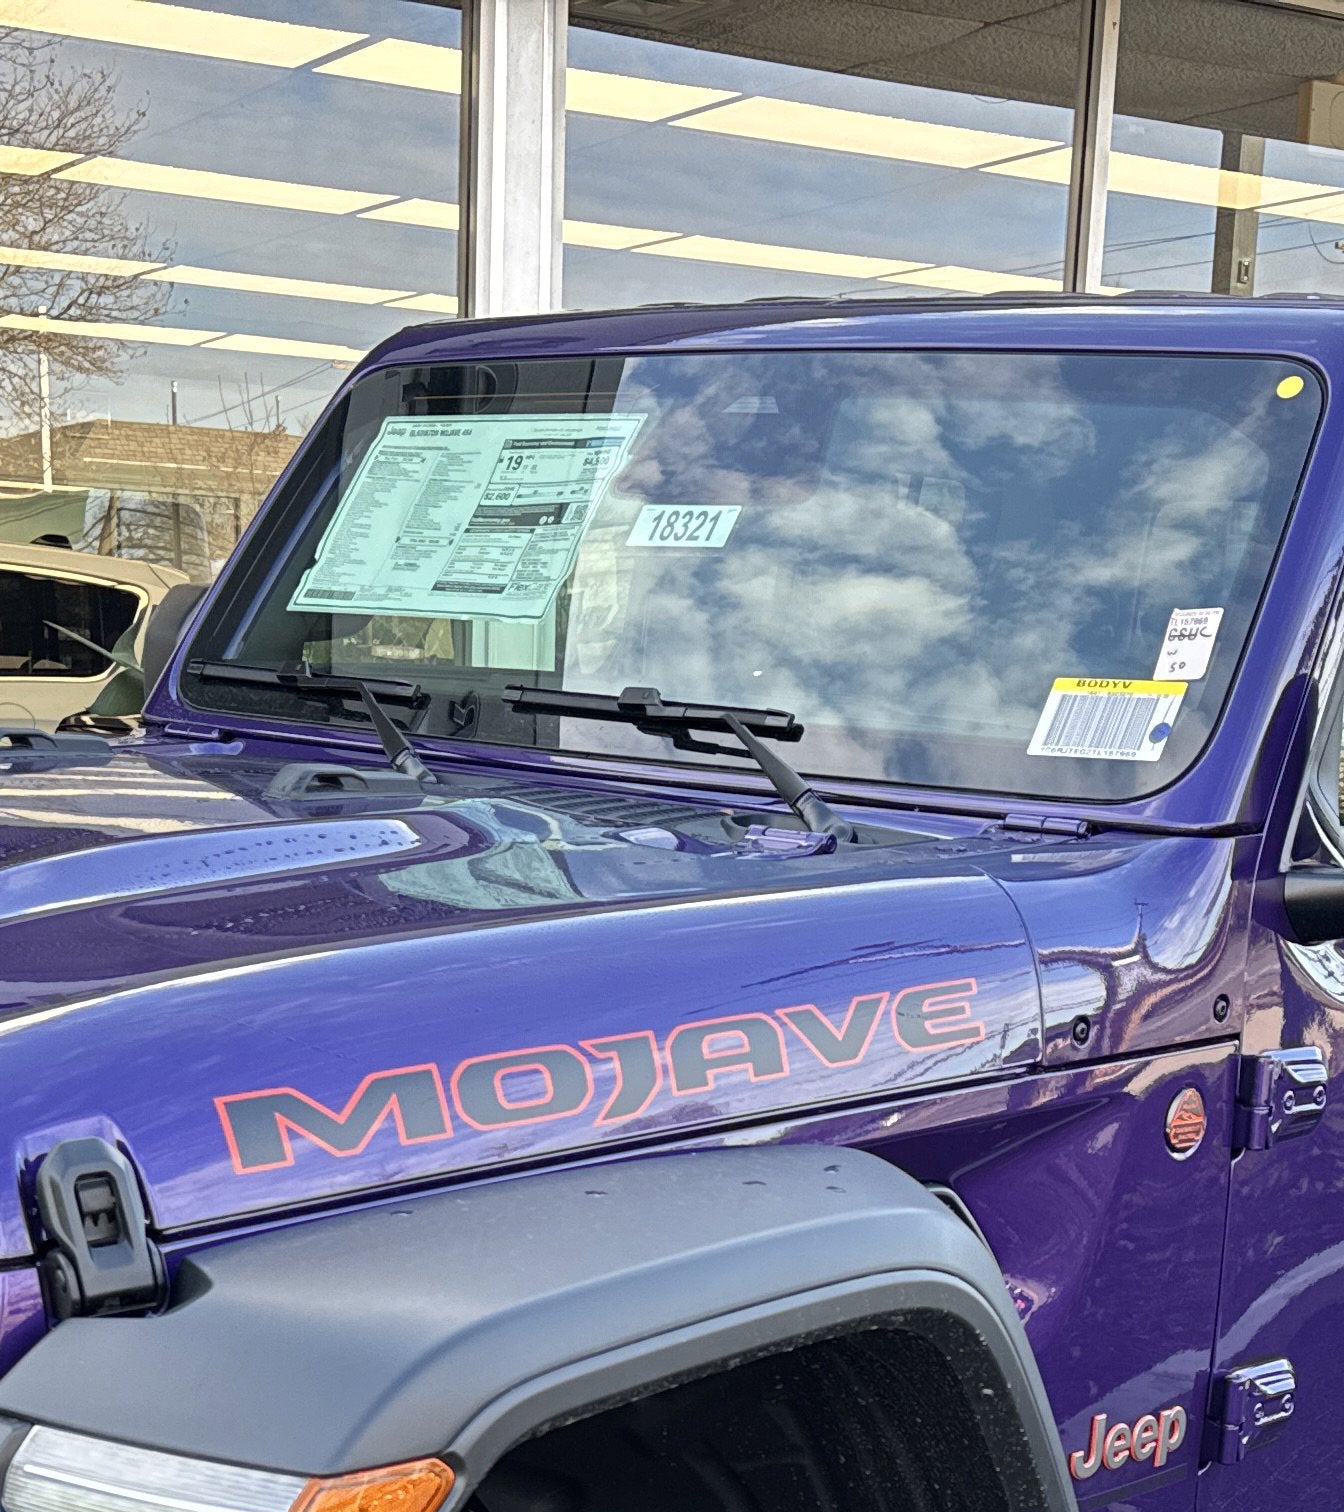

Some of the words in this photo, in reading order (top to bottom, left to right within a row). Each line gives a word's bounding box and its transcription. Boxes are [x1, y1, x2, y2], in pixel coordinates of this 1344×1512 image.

[505, 455, 524, 471] 19
[648, 509, 723, 541] 18321
[1076, 679, 1133, 689] BODYV
[213, 977, 985, 1175] MOJAVE
[1070, 1405, 1187, 1481] Jeep
